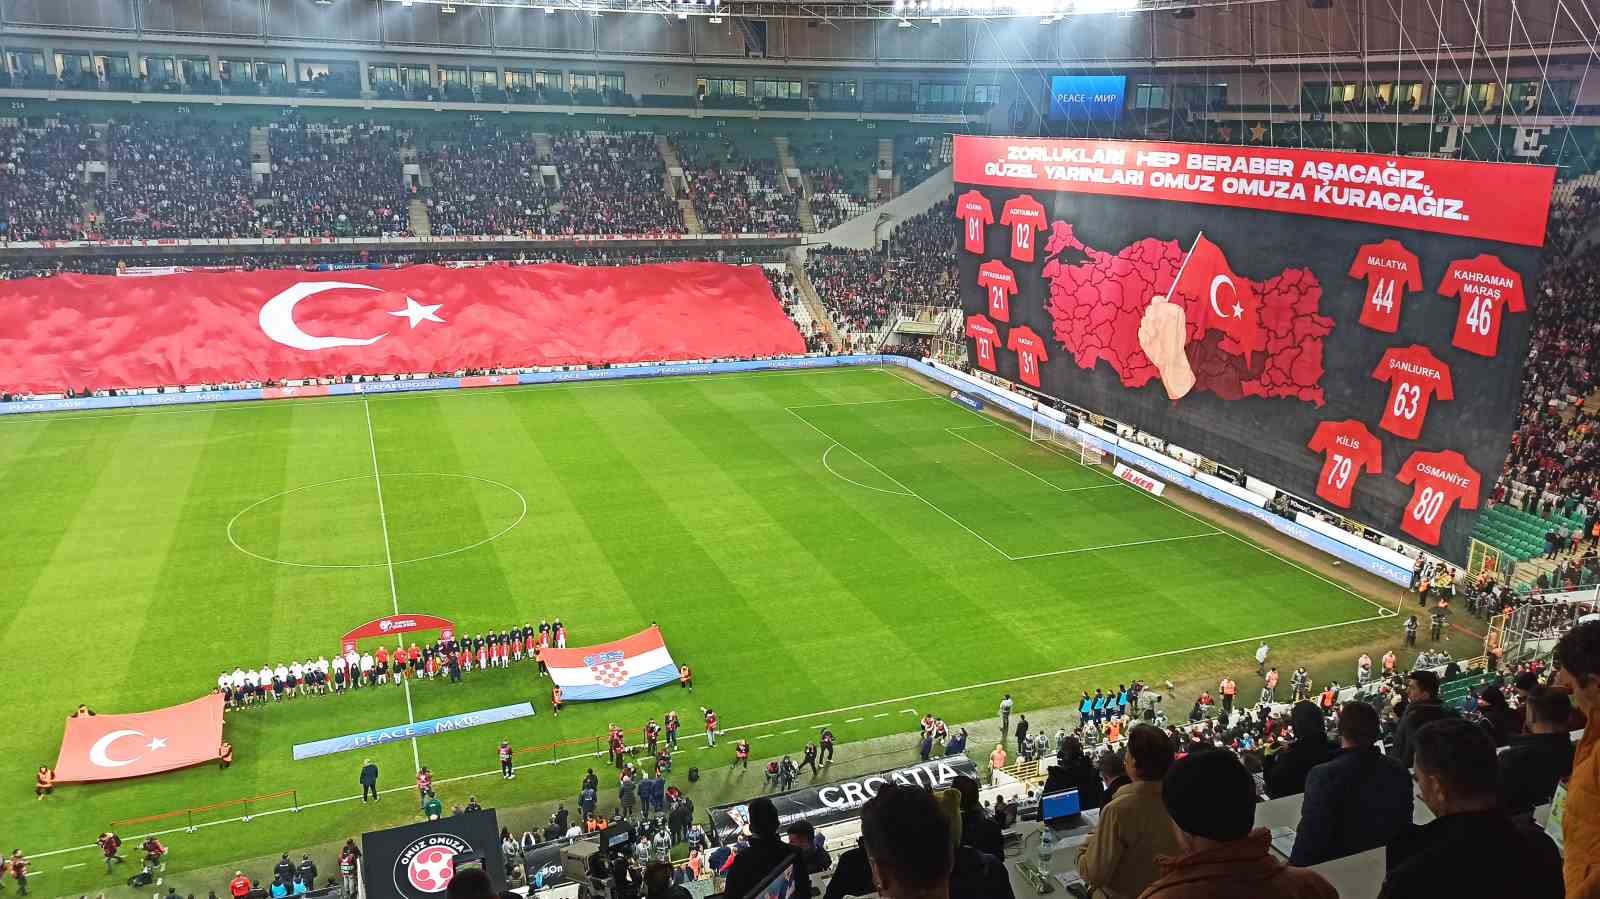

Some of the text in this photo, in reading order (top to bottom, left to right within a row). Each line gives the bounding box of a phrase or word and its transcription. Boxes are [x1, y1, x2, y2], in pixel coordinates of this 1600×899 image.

[1057, 94, 1087, 103] PEACE
[1007, 146, 1430, 191] ZORLUKLARI HEP BERABER AŞACAĞIZ,
[984, 159, 1469, 221] GÜZEL YARINLARI OMUZ OMUZA KURACAĞIZ.
[969, 217, 979, 240] 01
[1016, 223, 1030, 248] 02
[1367, 256, 1408, 272] MALATYA
[1454, 270, 1514, 289] KAHRAMAN
[992, 286, 1004, 309] 21
[1372, 277, 1395, 314] 44
[1463, 283, 1501, 300] MARAŞ
[1466, 296, 1492, 335] 46
[979, 337, 989, 360] 27
[1022, 351, 1034, 375] 31
[1389, 359, 1441, 380] ŞANLIURFA
[1394, 382, 1421, 420] 63
[1336, 435, 1360, 449] KİLİS
[1120, 469, 1155, 491] ÜLKER
[1328, 454, 1351, 489] 79
[1417, 463, 1471, 488] OSMANİYE
[1413, 487, 1445, 525] 80
[1372, 561, 1410, 583] PEACE
[355, 727, 416, 746] PEACE
[401, 837, 465, 865] OMUZ OMUZA
